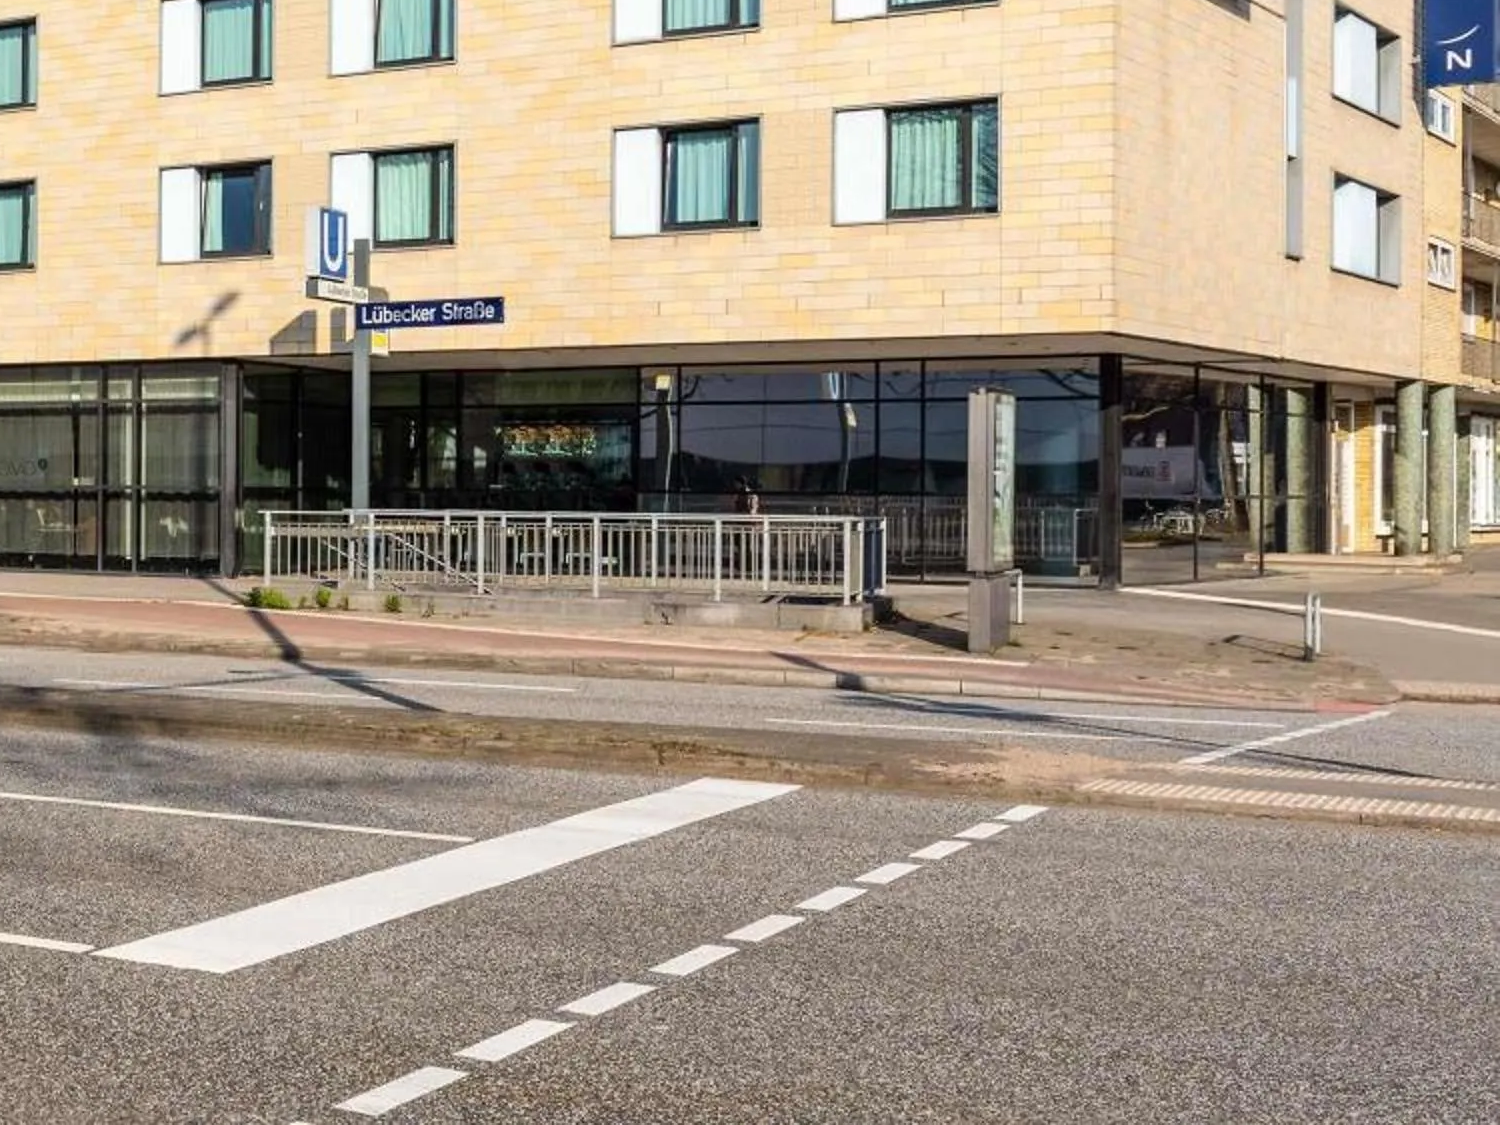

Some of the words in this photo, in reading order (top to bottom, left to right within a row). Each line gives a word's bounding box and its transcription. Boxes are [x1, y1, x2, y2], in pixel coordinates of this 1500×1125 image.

[323, 211, 344, 272] U
[361, 305, 436, 325] Lübecker
[441, 301, 495, 320] Straße
